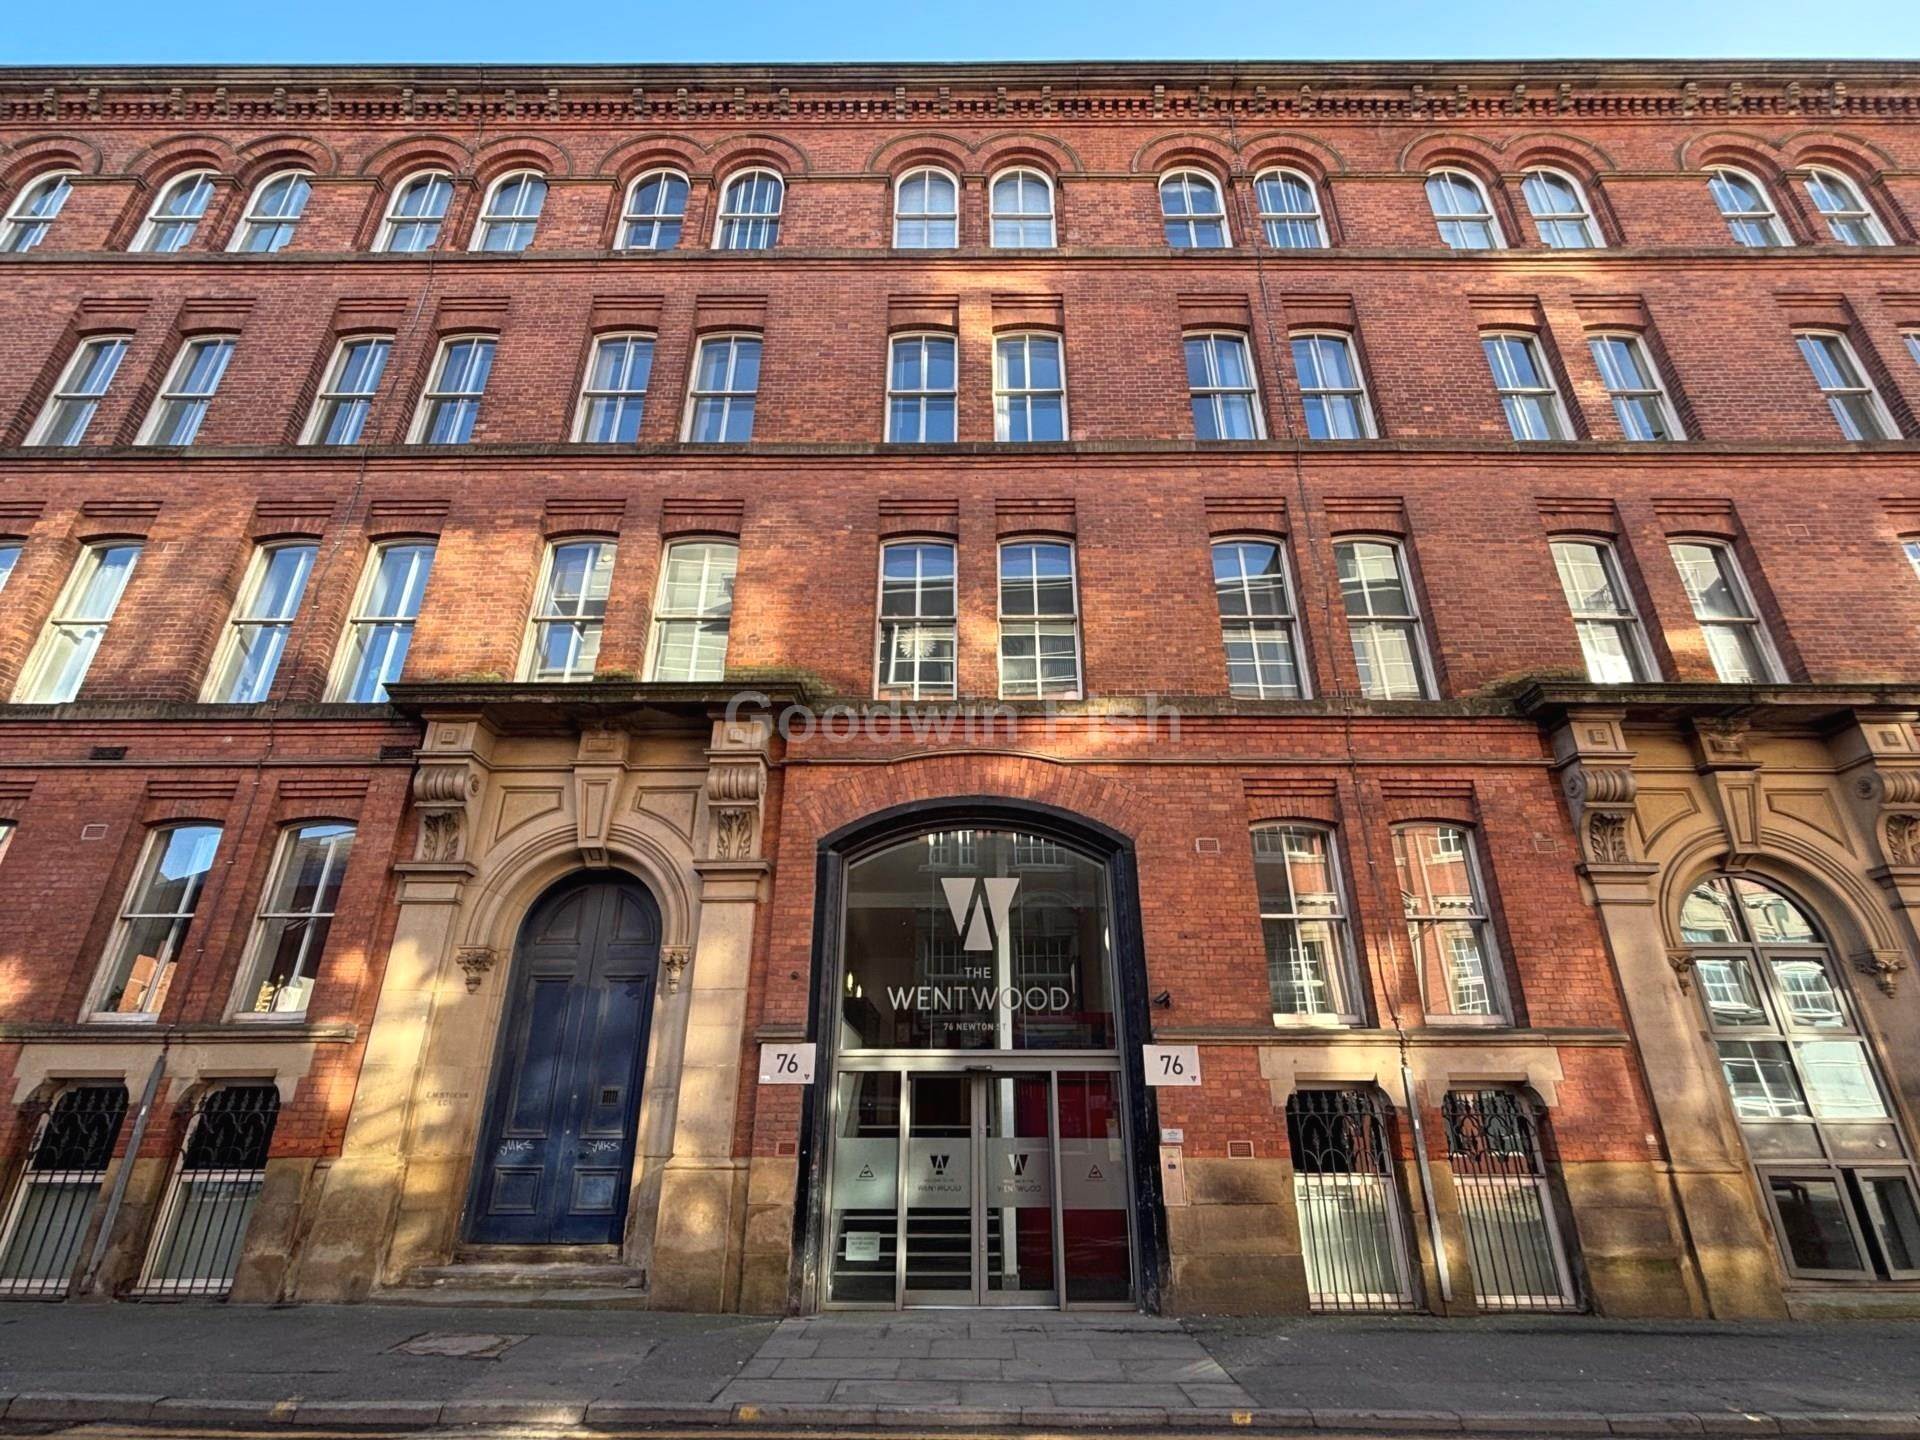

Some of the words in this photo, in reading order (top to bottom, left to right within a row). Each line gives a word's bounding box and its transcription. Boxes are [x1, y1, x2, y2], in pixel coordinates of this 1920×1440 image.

[964, 967, 992, 979] THE
[887, 986, 1070, 1011] WENTWOOD
[943, 1022, 954, 1031] 76
[956, 1022, 994, 1031] NEWTON
[776, 1053, 799, 1074] 76
[1160, 1055, 1184, 1075] 76
